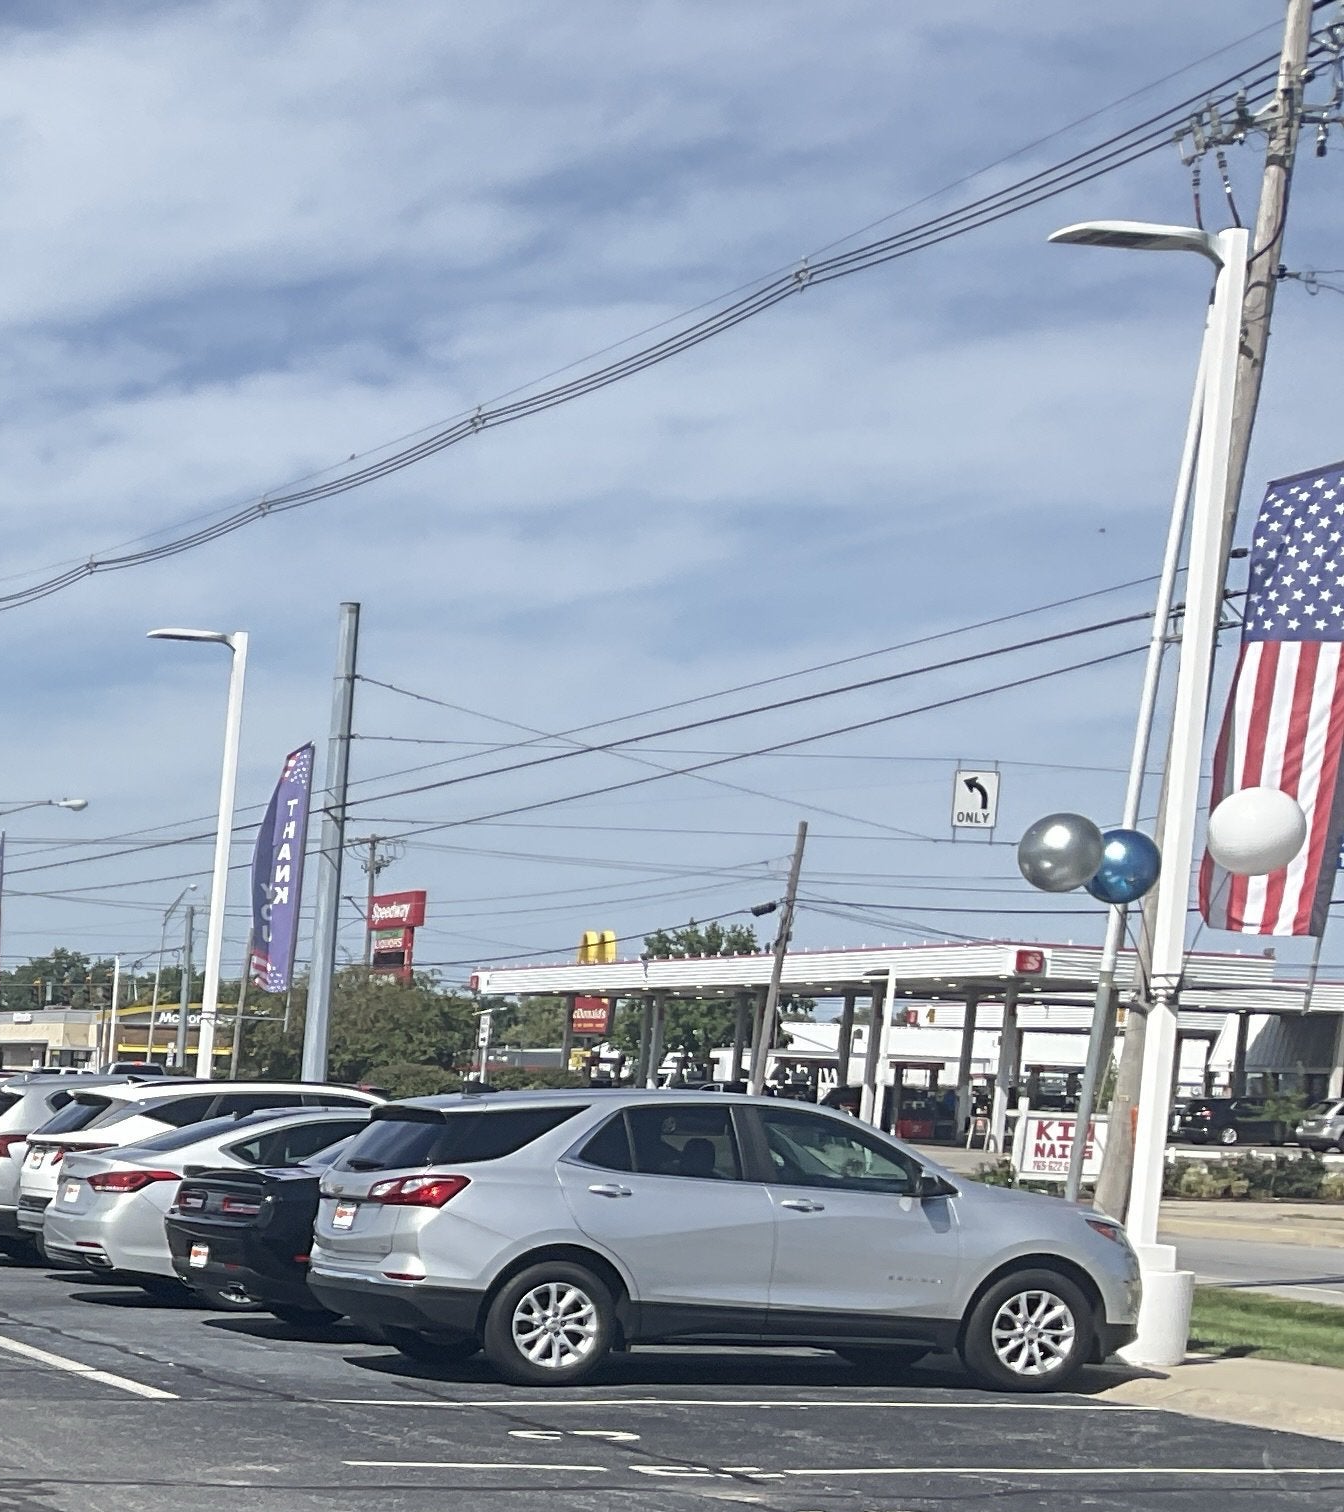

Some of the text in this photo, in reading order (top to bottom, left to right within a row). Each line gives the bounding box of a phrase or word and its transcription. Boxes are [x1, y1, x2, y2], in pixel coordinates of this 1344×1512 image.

[957, 811, 990, 823] ONLY
[372, 903, 410, 925] Speedway
[1034, 1142, 1093, 1160] NAIS
